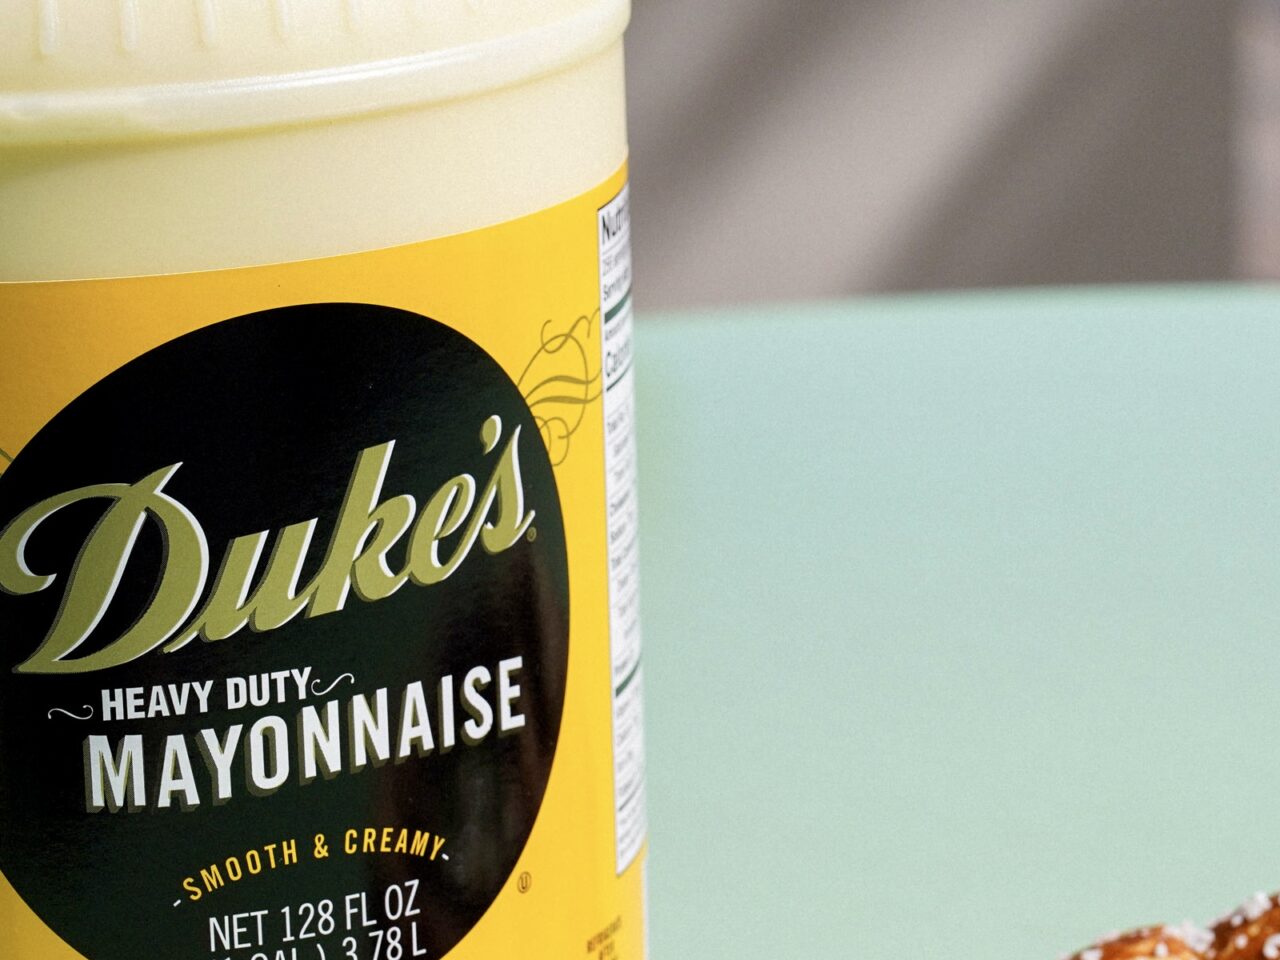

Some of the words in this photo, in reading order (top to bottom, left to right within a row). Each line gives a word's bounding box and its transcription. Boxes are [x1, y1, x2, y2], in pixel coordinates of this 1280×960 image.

[0, 414, 536, 674] Duke's
[100, 680, 214, 721] HEAVY
[226, 667, 314, 711] DUTY
[85, 656, 526, 812] MAYONNAISE
[182, 839, 298, 901] SMOOTH
[313, 833, 329, 859] &
[344, 827, 446, 861] CREAMY
[208, 909, 269, 952] NET
[280, 899, 336, 942] 128
[345, 891, 377, 931] FL
[384, 879, 421, 921] OZ
[411, 921, 427, 957] L
